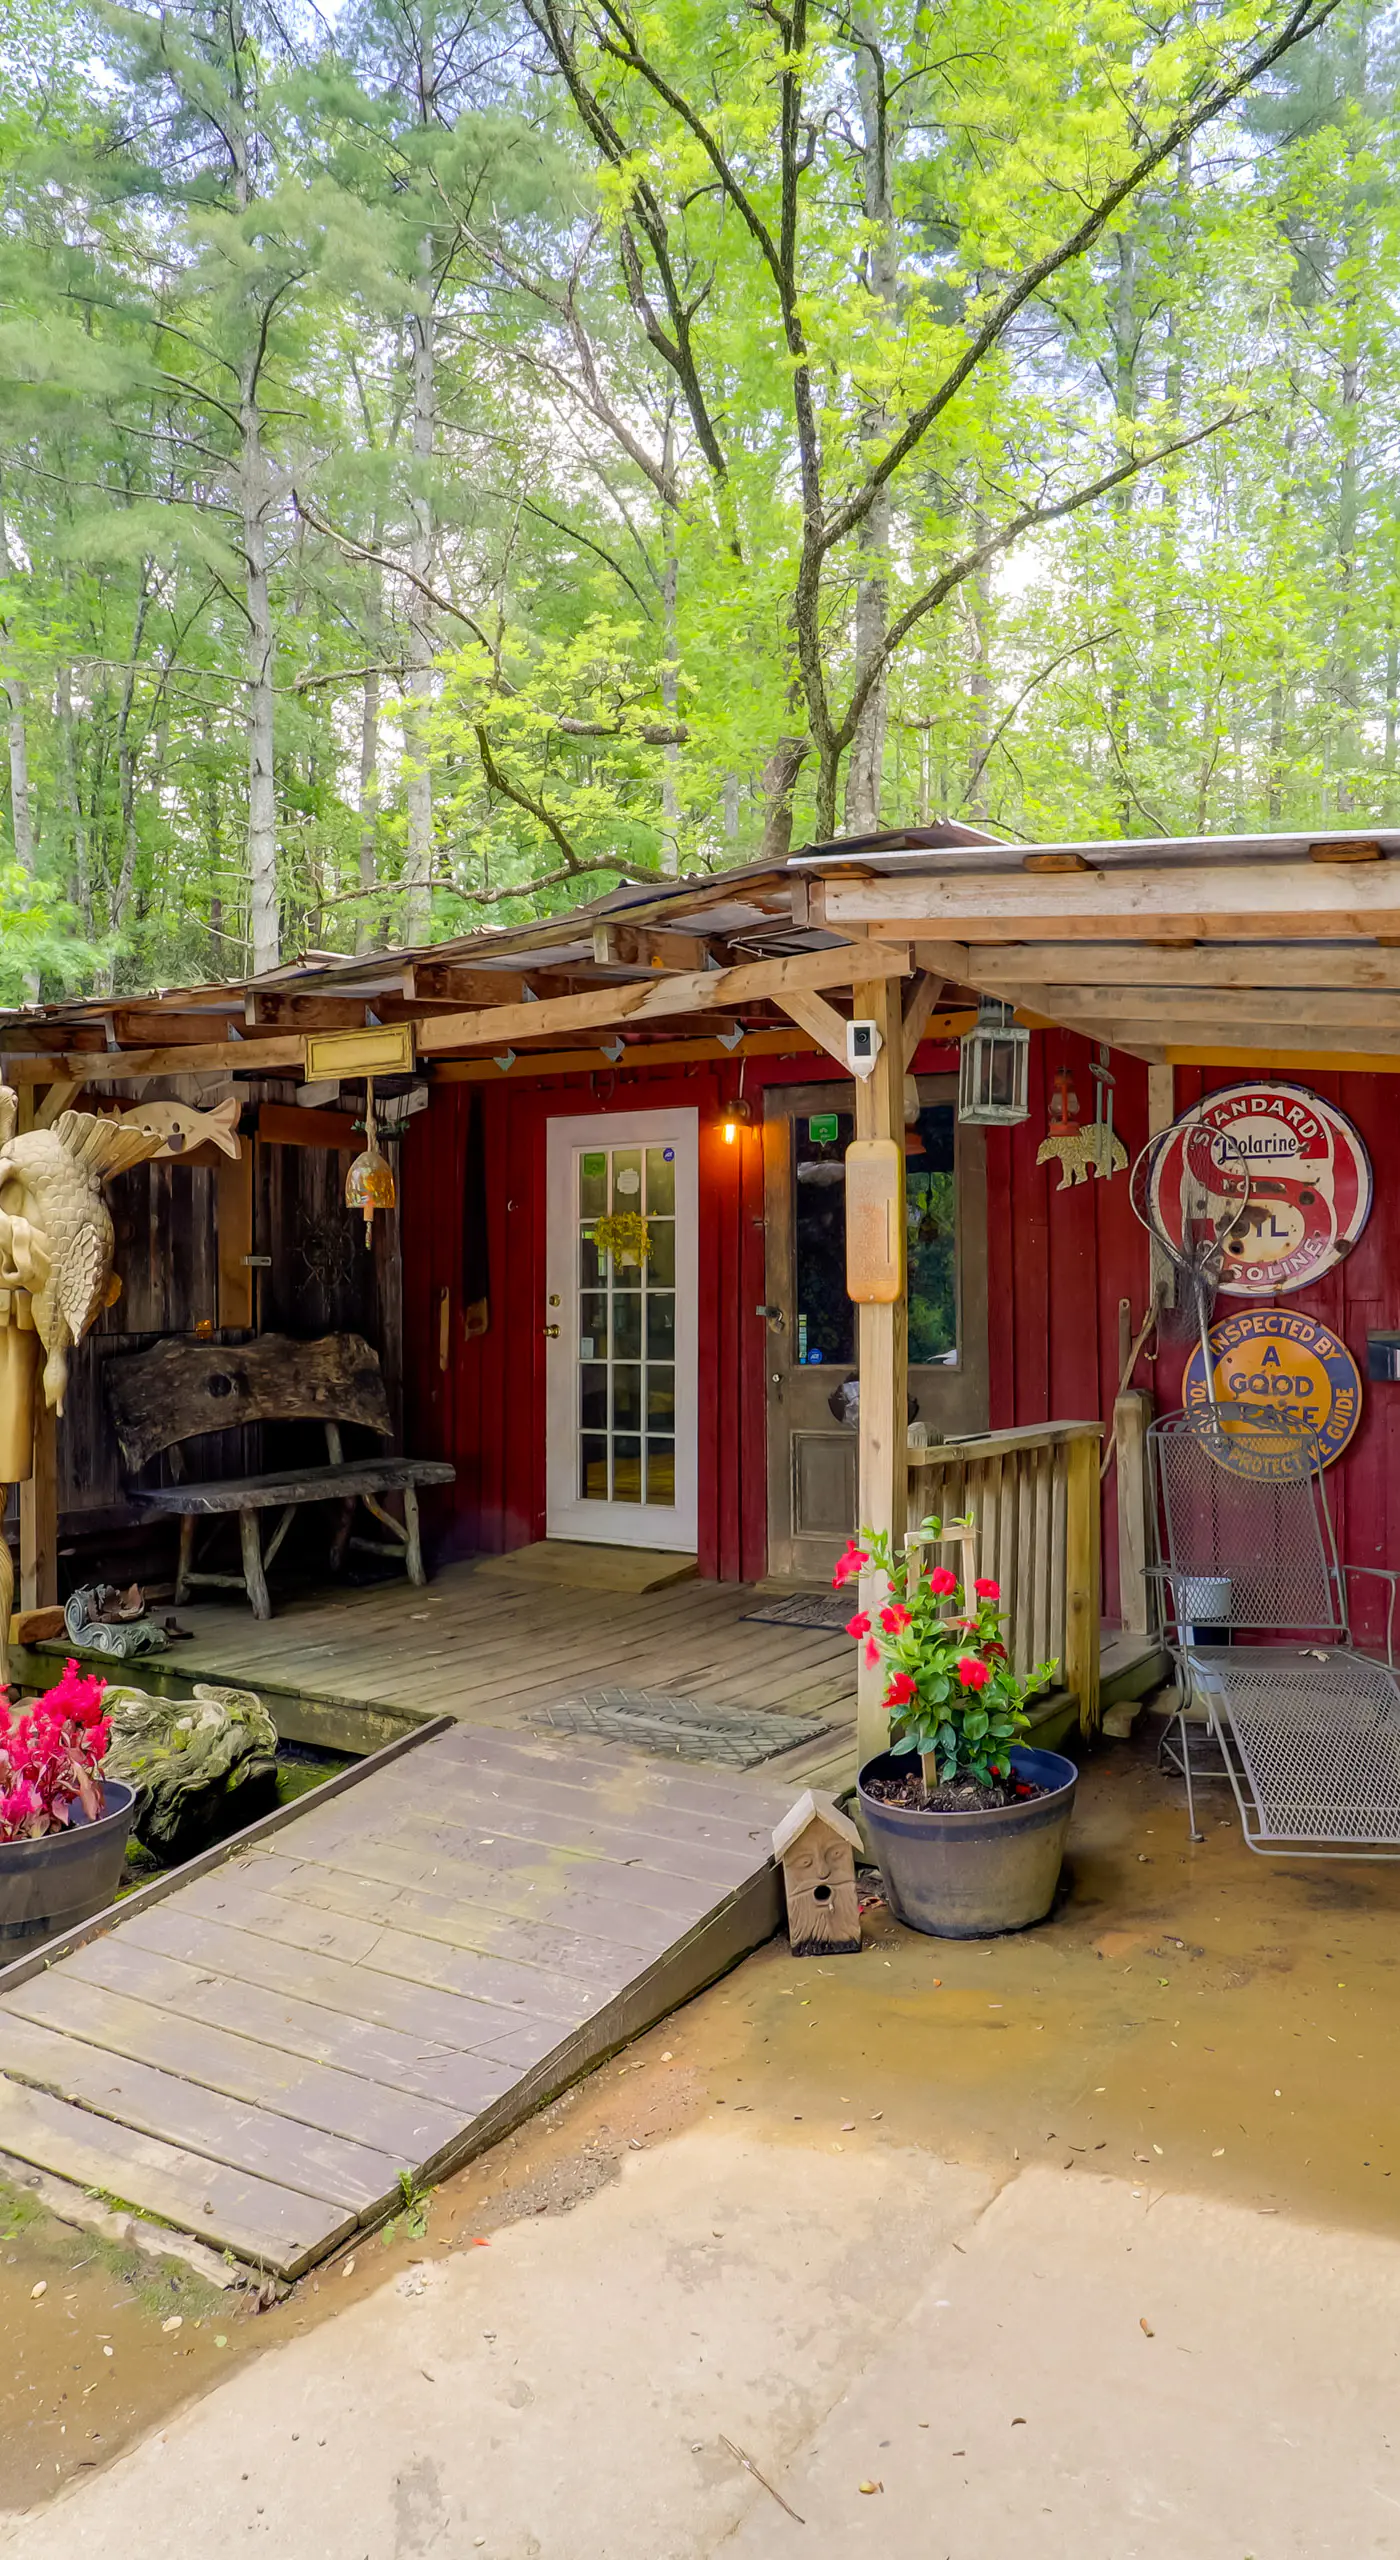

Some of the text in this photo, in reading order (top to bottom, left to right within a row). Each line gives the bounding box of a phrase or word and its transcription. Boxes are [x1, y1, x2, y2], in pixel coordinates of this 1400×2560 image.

[1214, 1133, 1296, 1165] Polarine
[1230, 1214, 1289, 1238] IL
[1209, 1316, 1342, 1361] INSPECTED BY
[1261, 1345, 1281, 1367] A
[1229, 1372, 1315, 1397] GOOD
[1326, 1387, 1355, 1440] GUIDE
